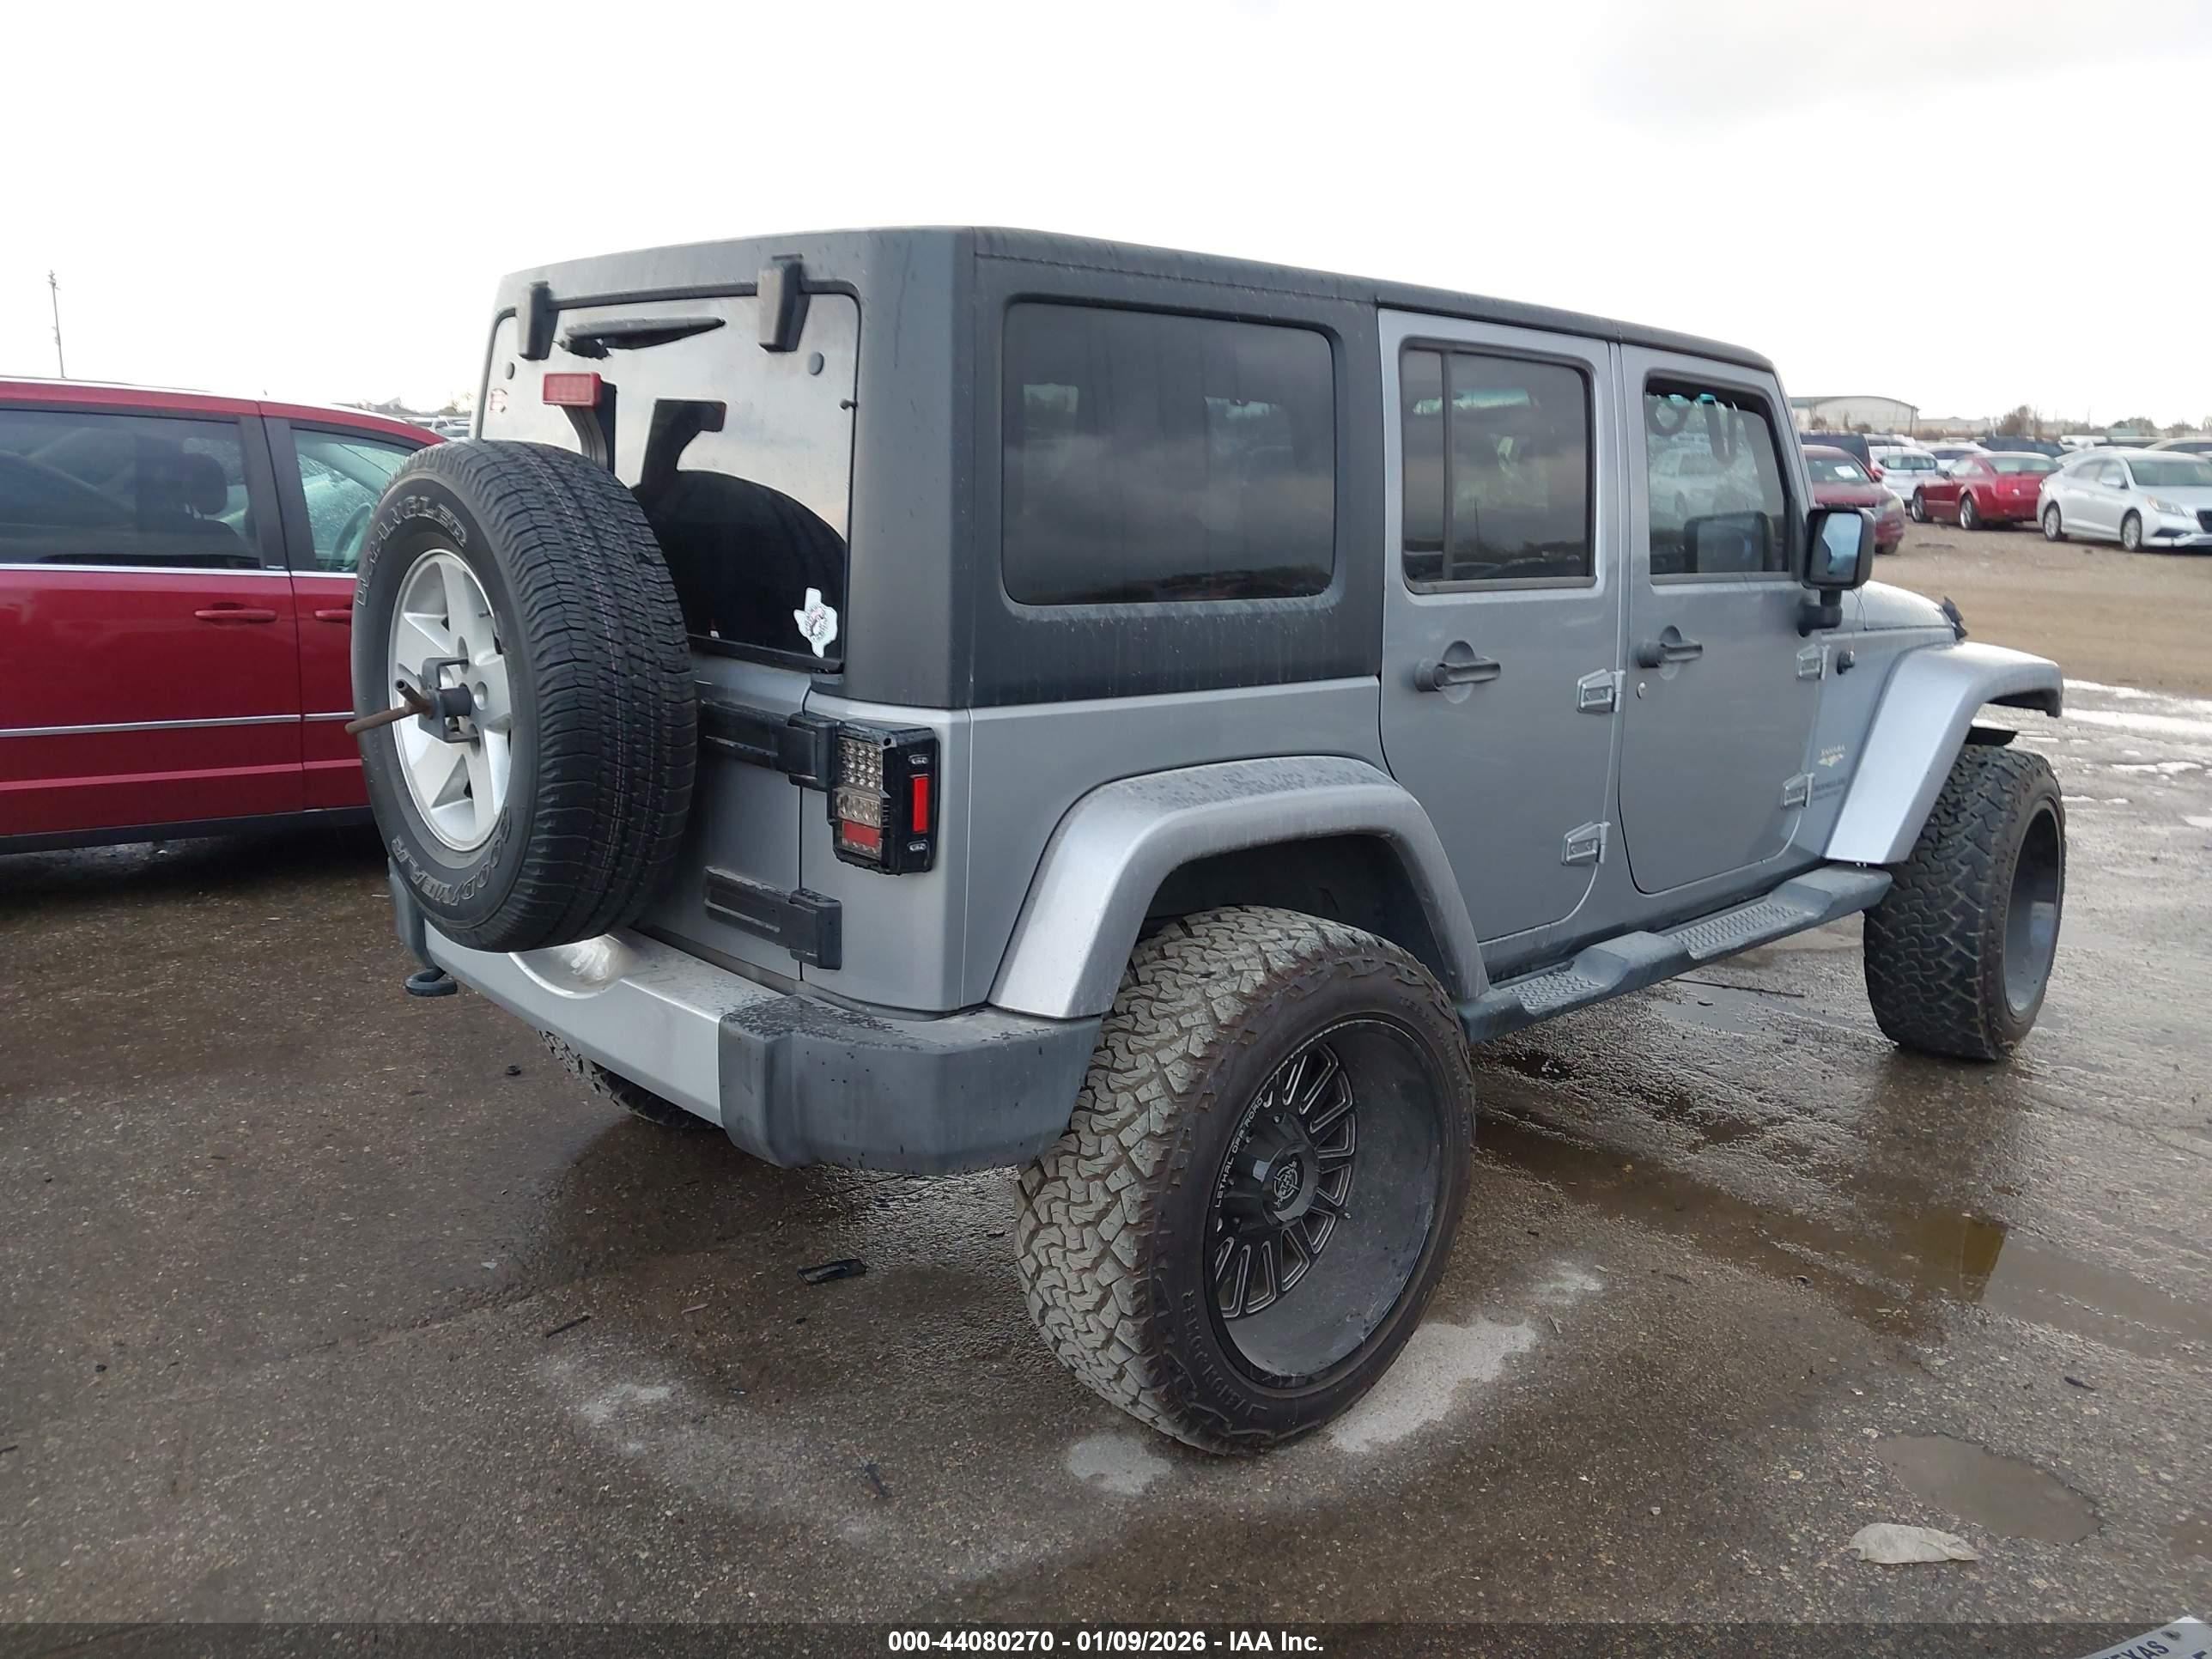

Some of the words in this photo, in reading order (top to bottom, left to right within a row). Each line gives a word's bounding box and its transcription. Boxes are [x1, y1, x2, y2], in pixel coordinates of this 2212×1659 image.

[391, 805, 512, 907] GOODYEAR
[1214, 1156, 1235, 1208] LETHAL
[1231, 1128, 1245, 1154] OFF
[1243, 1097, 1263, 1127] ROAD
